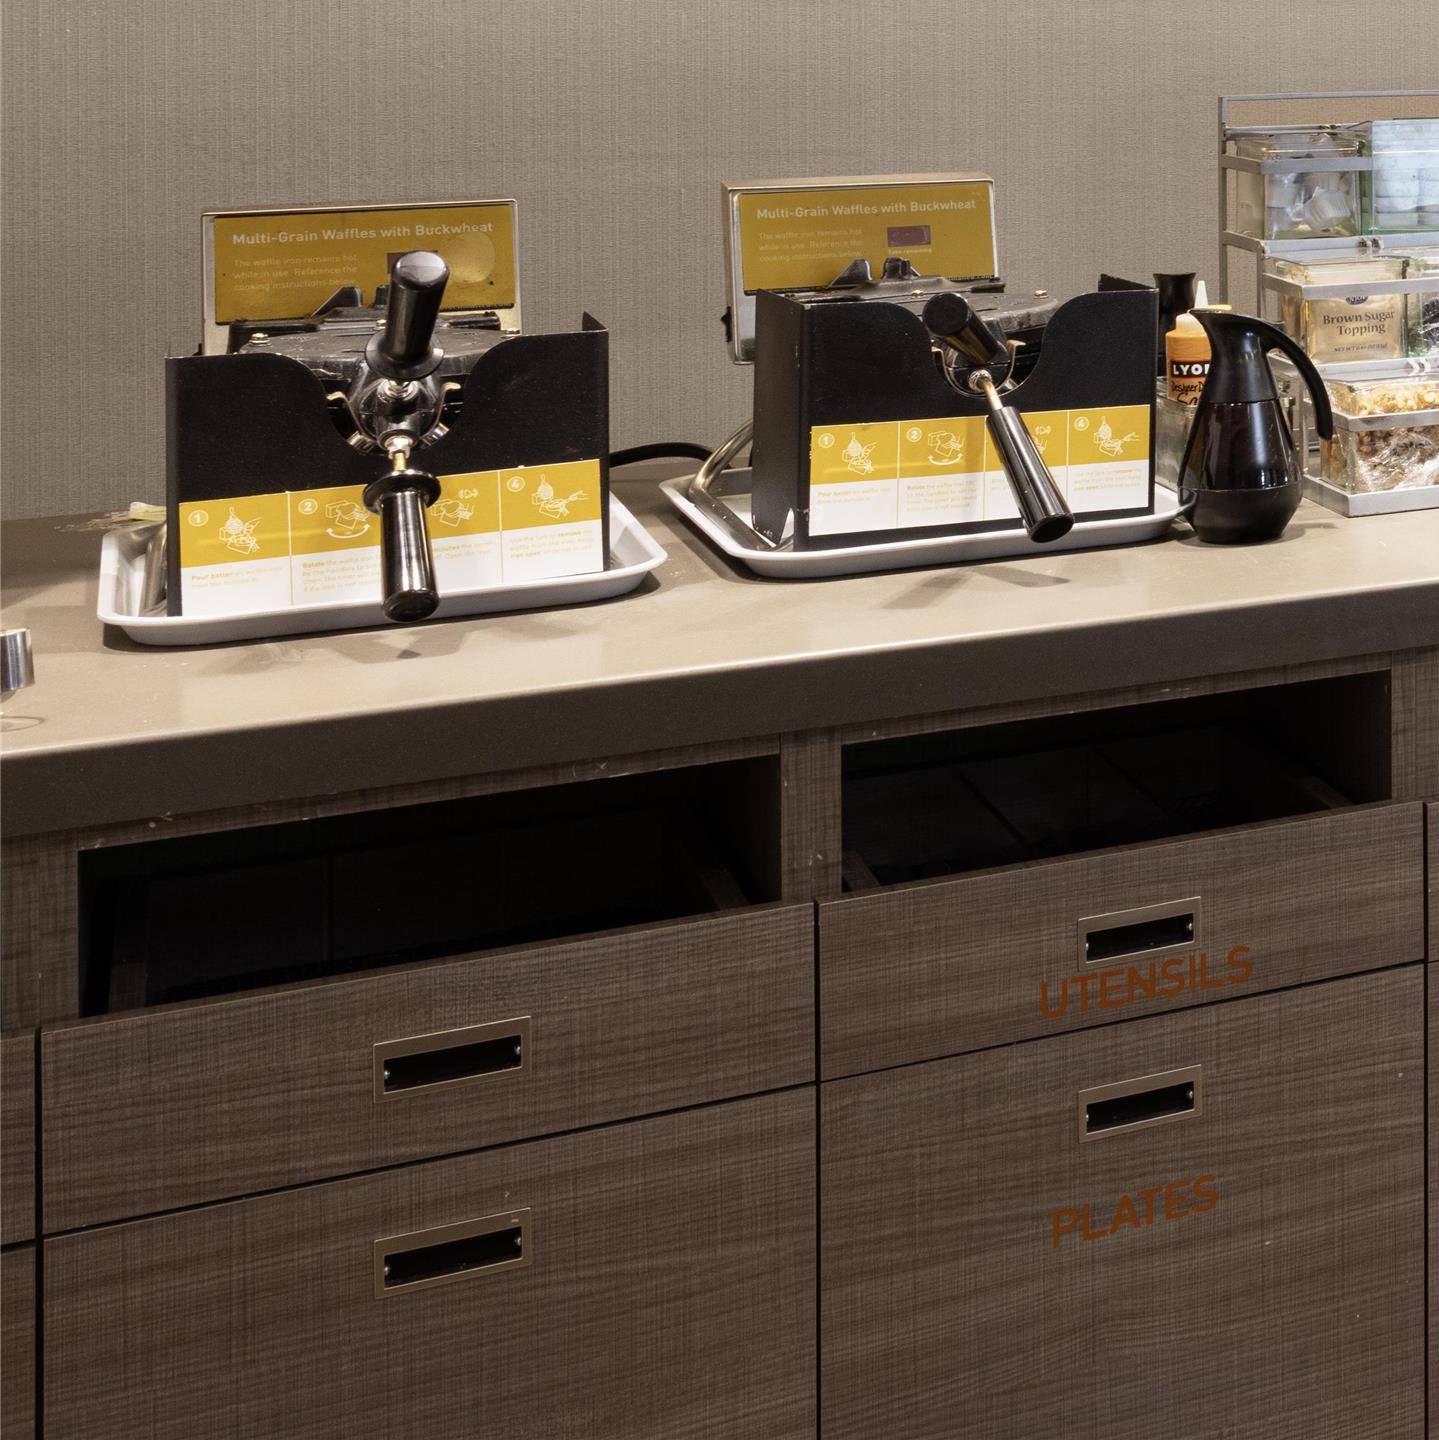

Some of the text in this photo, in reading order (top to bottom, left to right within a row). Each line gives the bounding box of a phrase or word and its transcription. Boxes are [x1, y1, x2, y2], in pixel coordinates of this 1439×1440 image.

[756, 199, 976, 220] Multi-Grain Waffles with Buckwheat
[233, 222, 493, 245] Multi-Grain Waffles with Buckwheat
[1323, 311, 1396, 325] Brown Sugar
[1336, 322, 1387, 336] Topping
[1040, 945, 1254, 1019] UTENSILS
[1051, 1173, 1220, 1250] PLATES
